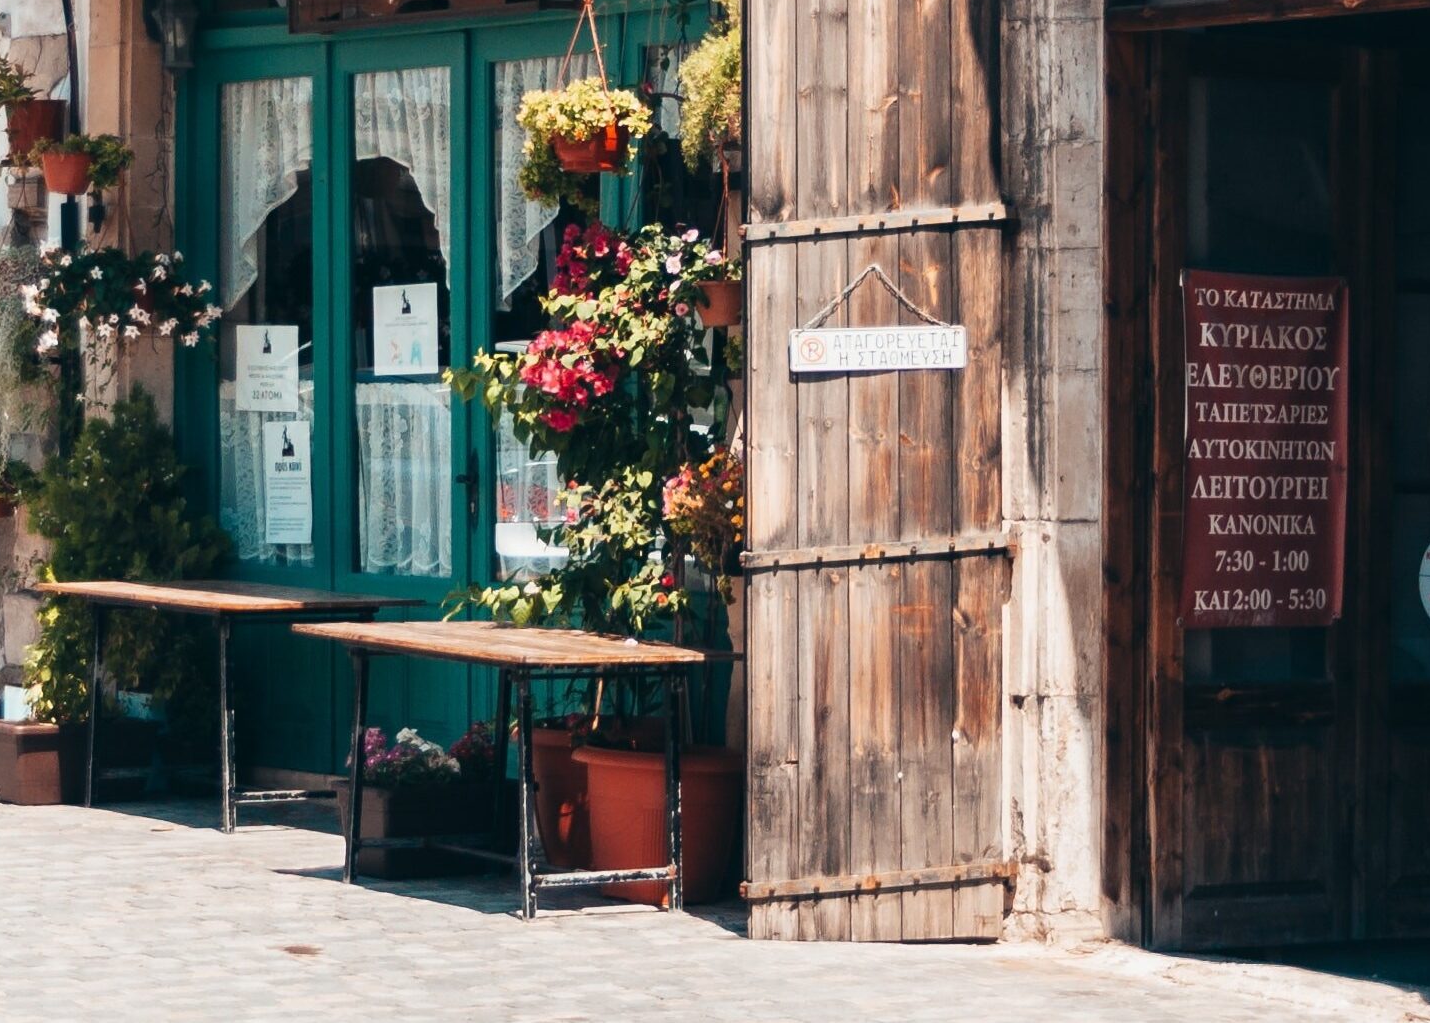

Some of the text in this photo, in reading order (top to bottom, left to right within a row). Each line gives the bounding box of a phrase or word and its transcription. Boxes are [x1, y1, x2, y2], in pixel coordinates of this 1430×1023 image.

[1195, 288, 1335, 311] ΤΟ ΚΑΤΑΣΤΗΜΑ
[833, 330, 960, 351] ΑΠΑΓΟΡΕΥΕΤΑΙ
[1199, 322, 1328, 351] ΚΥΡΙΑΚΟΣ
[839, 350, 952, 367] Η ΣΤΑΘΜΕΥΣΗ
[1186, 362, 1340, 391] ΕΛΕΥΘΕΡΙΟΥ
[1195, 402, 1329, 425] ΤΑΠΕΤΣΑΡΙΕΣ
[1188, 439, 1336, 462] ΑΥΤΟΚΙΝΗΤΩΝ
[1191, 476, 1329, 500] ΛΕΙΤΟΥΡΓΕΙ
[1208, 514, 1316, 536] ΚΑΝΟΝΙΚΑ
[1215, 550, 1254, 572] 7:30
[1273, 550, 1309, 572] 1:00
[1288, 588, 1326, 610] 5:30
